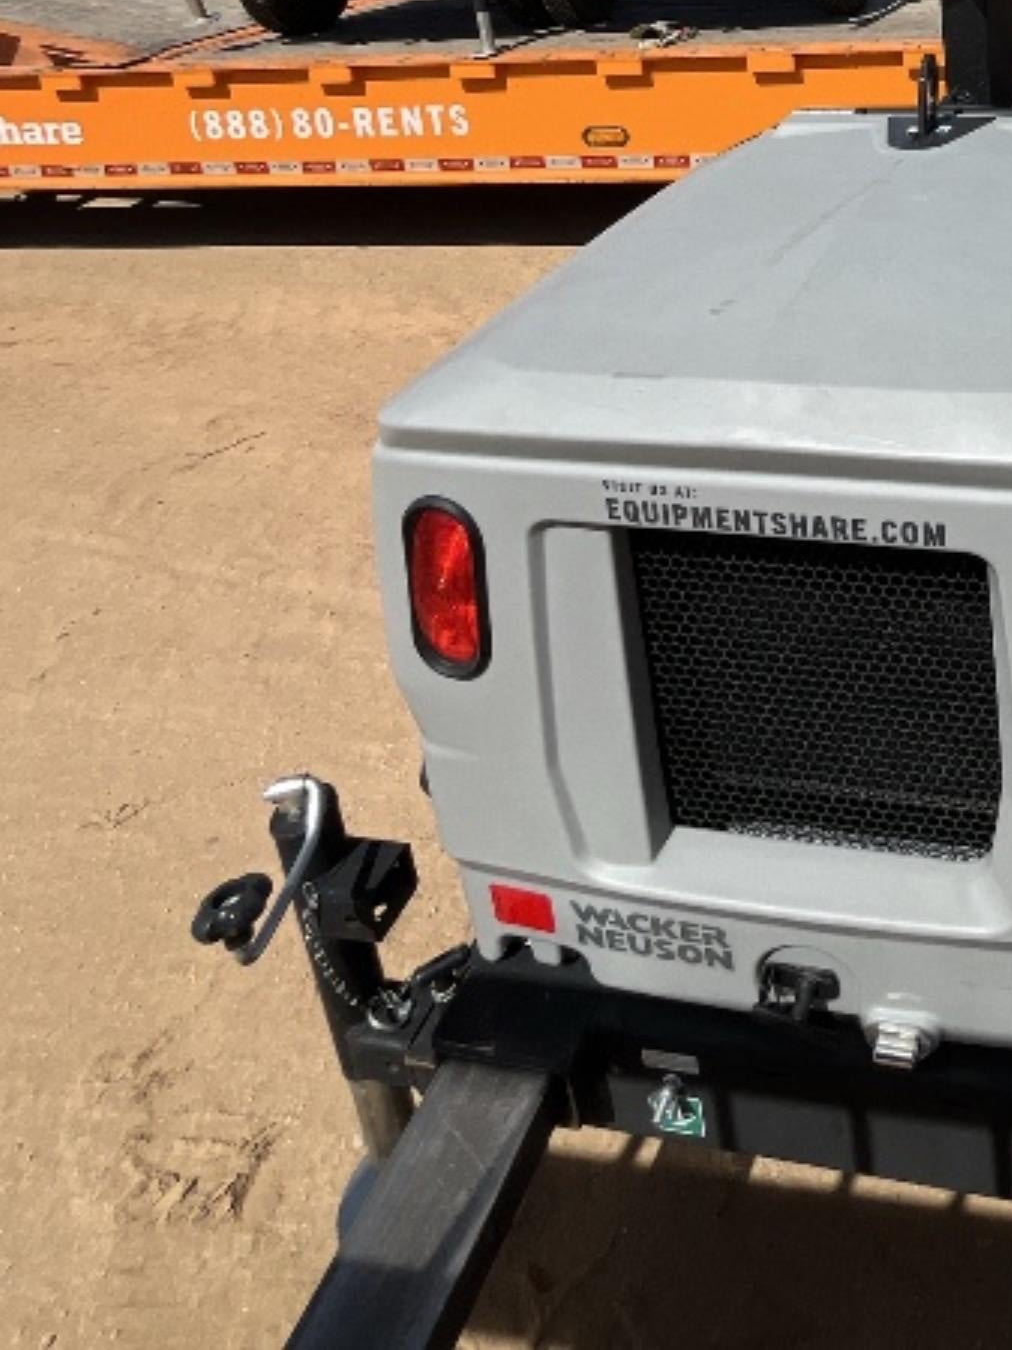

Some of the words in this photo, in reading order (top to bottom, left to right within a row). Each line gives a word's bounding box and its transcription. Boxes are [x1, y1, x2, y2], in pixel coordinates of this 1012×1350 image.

[190, 109, 284, 141] (888)
[290, 104, 470, 139] 80-RENTS
[605, 497, 947, 547] EQUIPMENTSHARE.COM
[569, 900, 730, 949] WACKER
[576, 923, 735, 971] NEUSON
